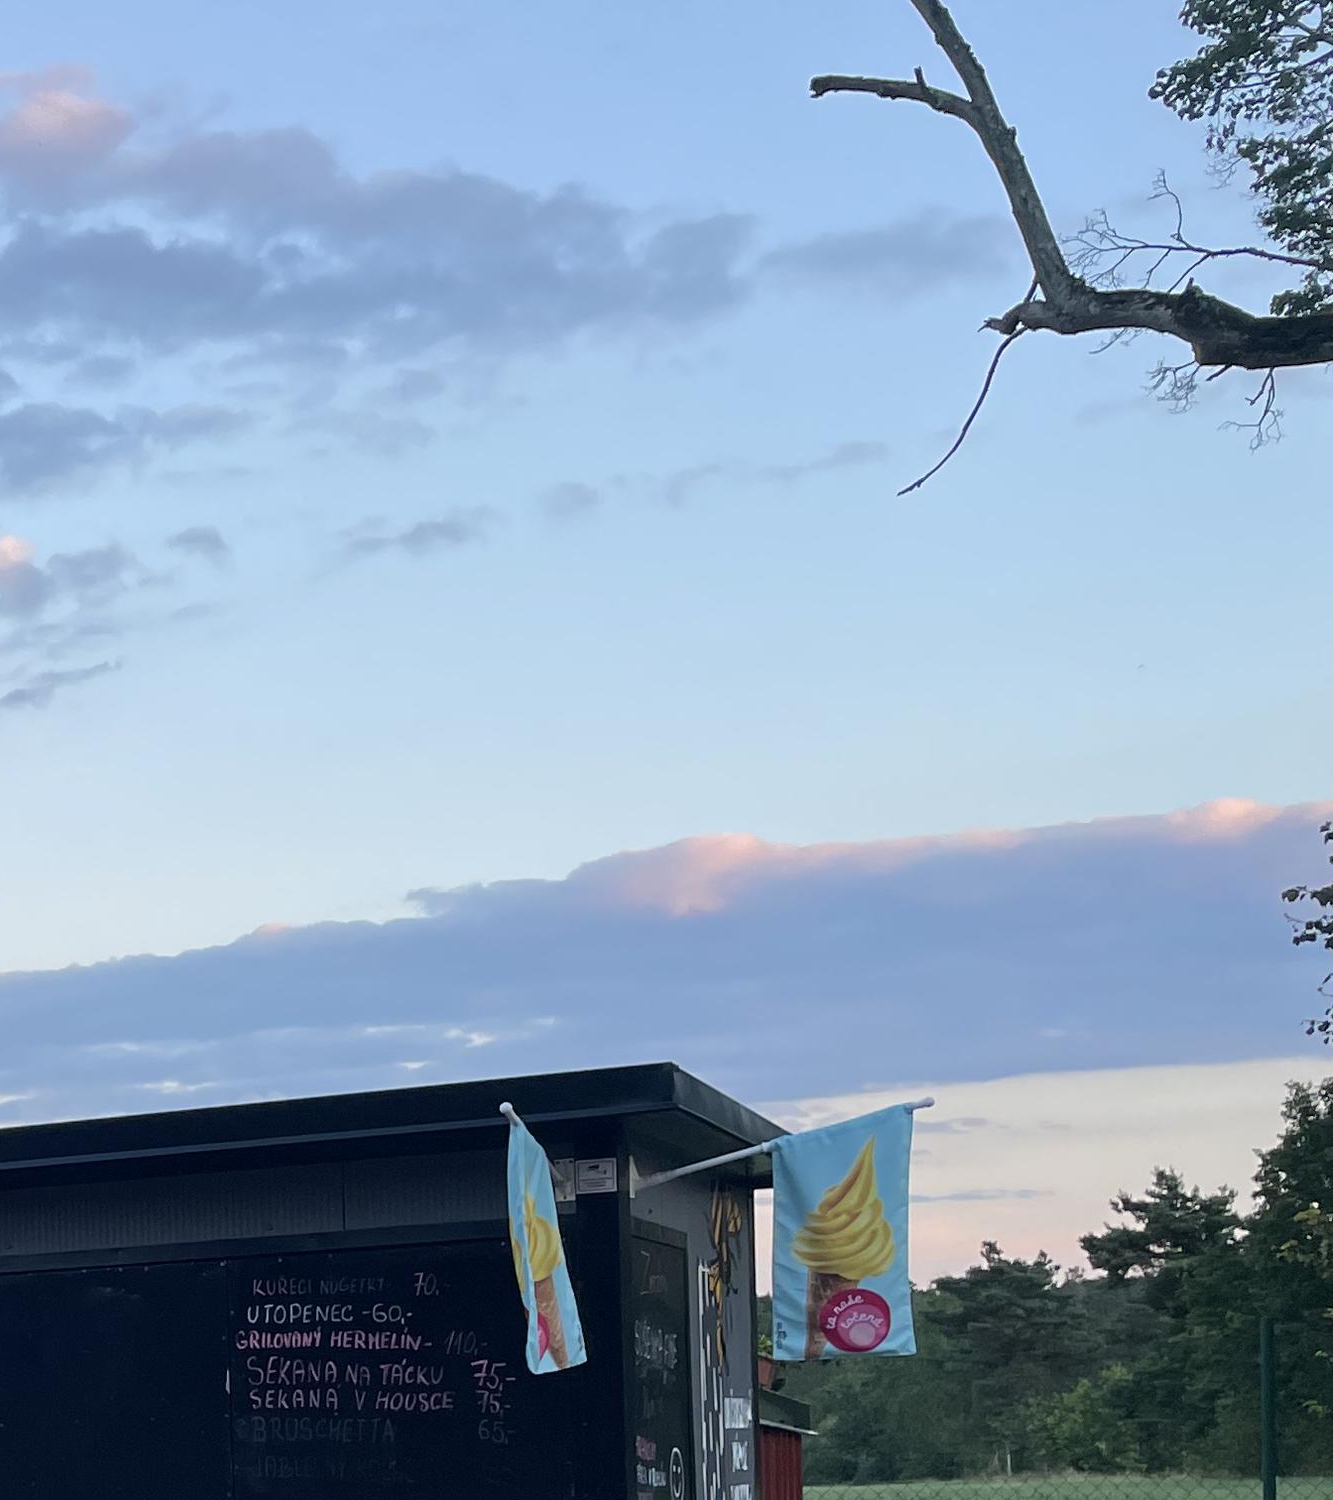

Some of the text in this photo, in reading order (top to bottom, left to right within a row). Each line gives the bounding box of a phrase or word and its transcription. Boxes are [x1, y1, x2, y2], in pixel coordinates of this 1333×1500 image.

[247, 1303, 354, 1324] UTOPENEC
[236, 1325, 322, 1350] GRILOVANÝ
[345, 1363, 370, 1385] NA
[355, 1390, 366, 1411] V
[375, 1390, 455, 1412] HOUSCE
